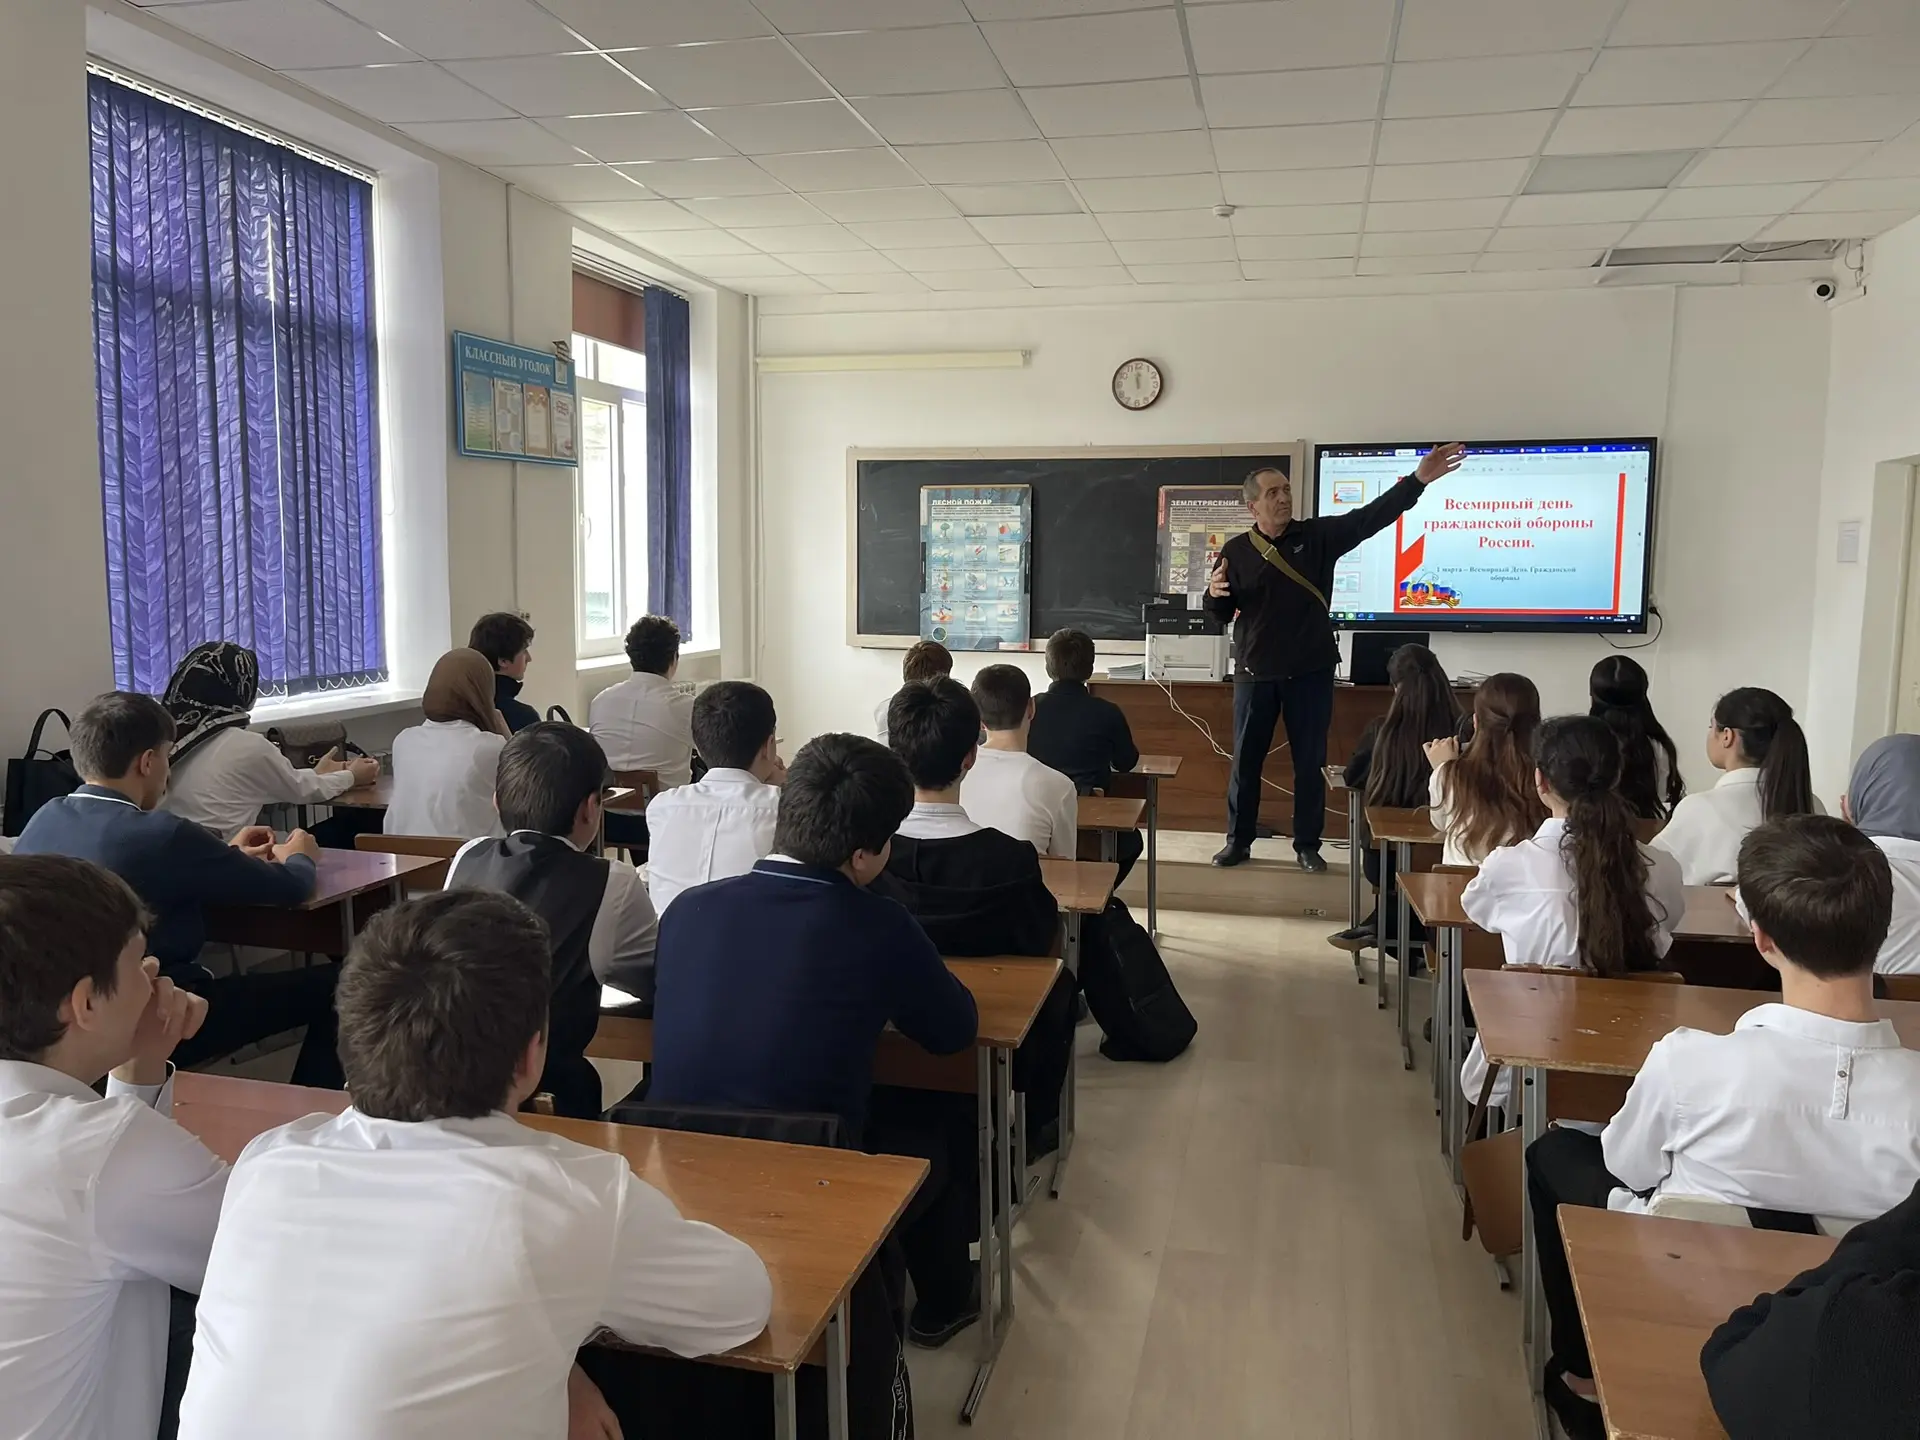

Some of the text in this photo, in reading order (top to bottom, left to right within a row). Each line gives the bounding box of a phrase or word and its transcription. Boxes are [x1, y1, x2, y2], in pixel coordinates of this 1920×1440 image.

[465, 346, 517, 368] КЛАССНЫЙ
[519, 359, 551, 376] УГОЛОК
[932, 498, 962, 506] ЛЕСНОЙ
[1444, 498, 1573, 513] Всемирный день
[1424, 517, 1594, 532] гражданской обороны
[1478, 536, 1535, 549] России.
[1469, 566, 1510, 574] Всемирный
[1530, 566, 1577, 574] Гражданской
